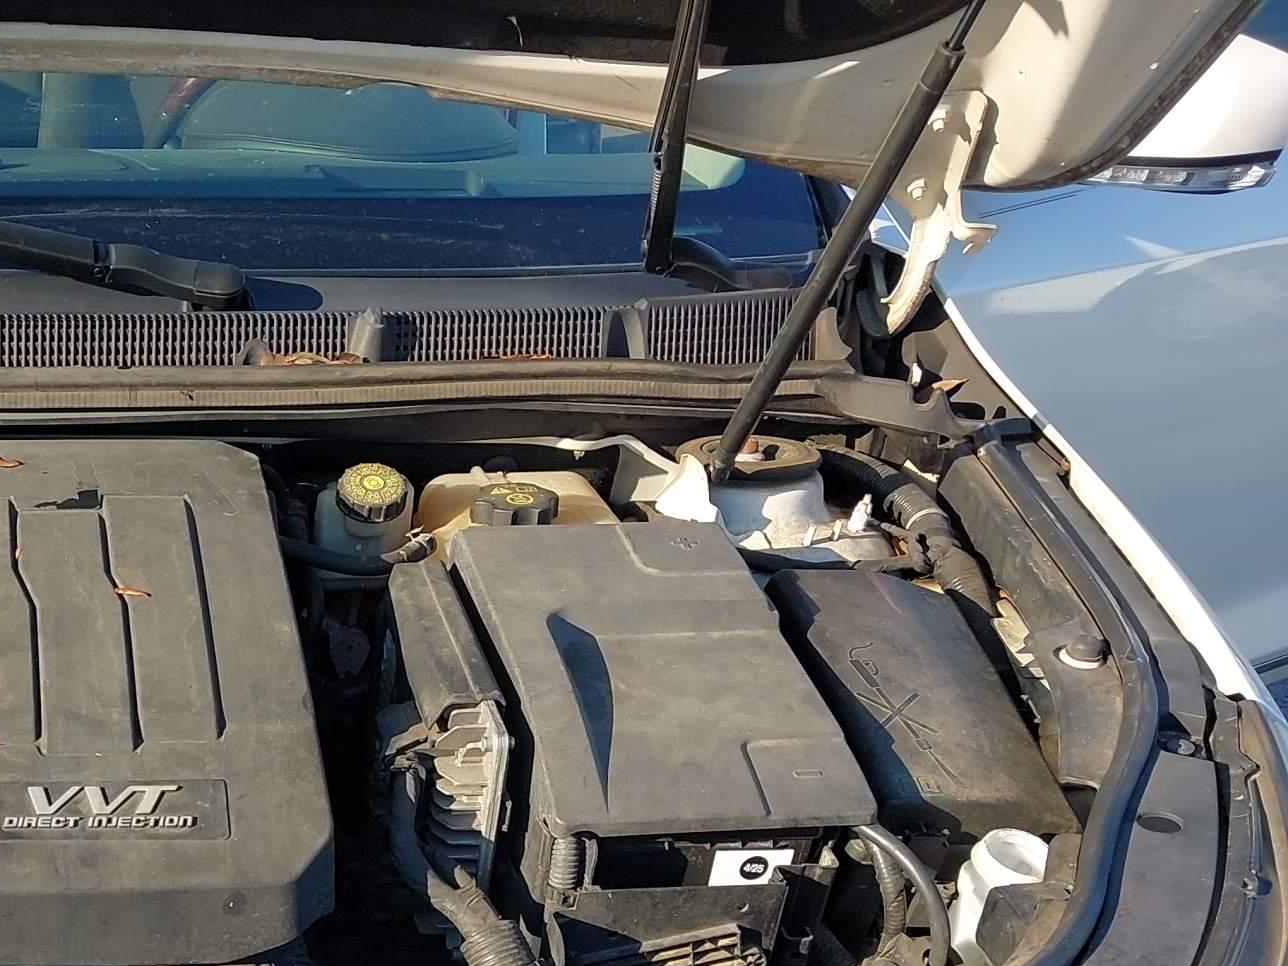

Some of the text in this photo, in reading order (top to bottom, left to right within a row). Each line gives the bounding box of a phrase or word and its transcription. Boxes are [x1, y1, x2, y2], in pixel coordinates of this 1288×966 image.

[27, 785, 182, 815] VVT
[3, 815, 194, 828] DIRECT INJECTION
[743, 863, 765, 873] 4/25
